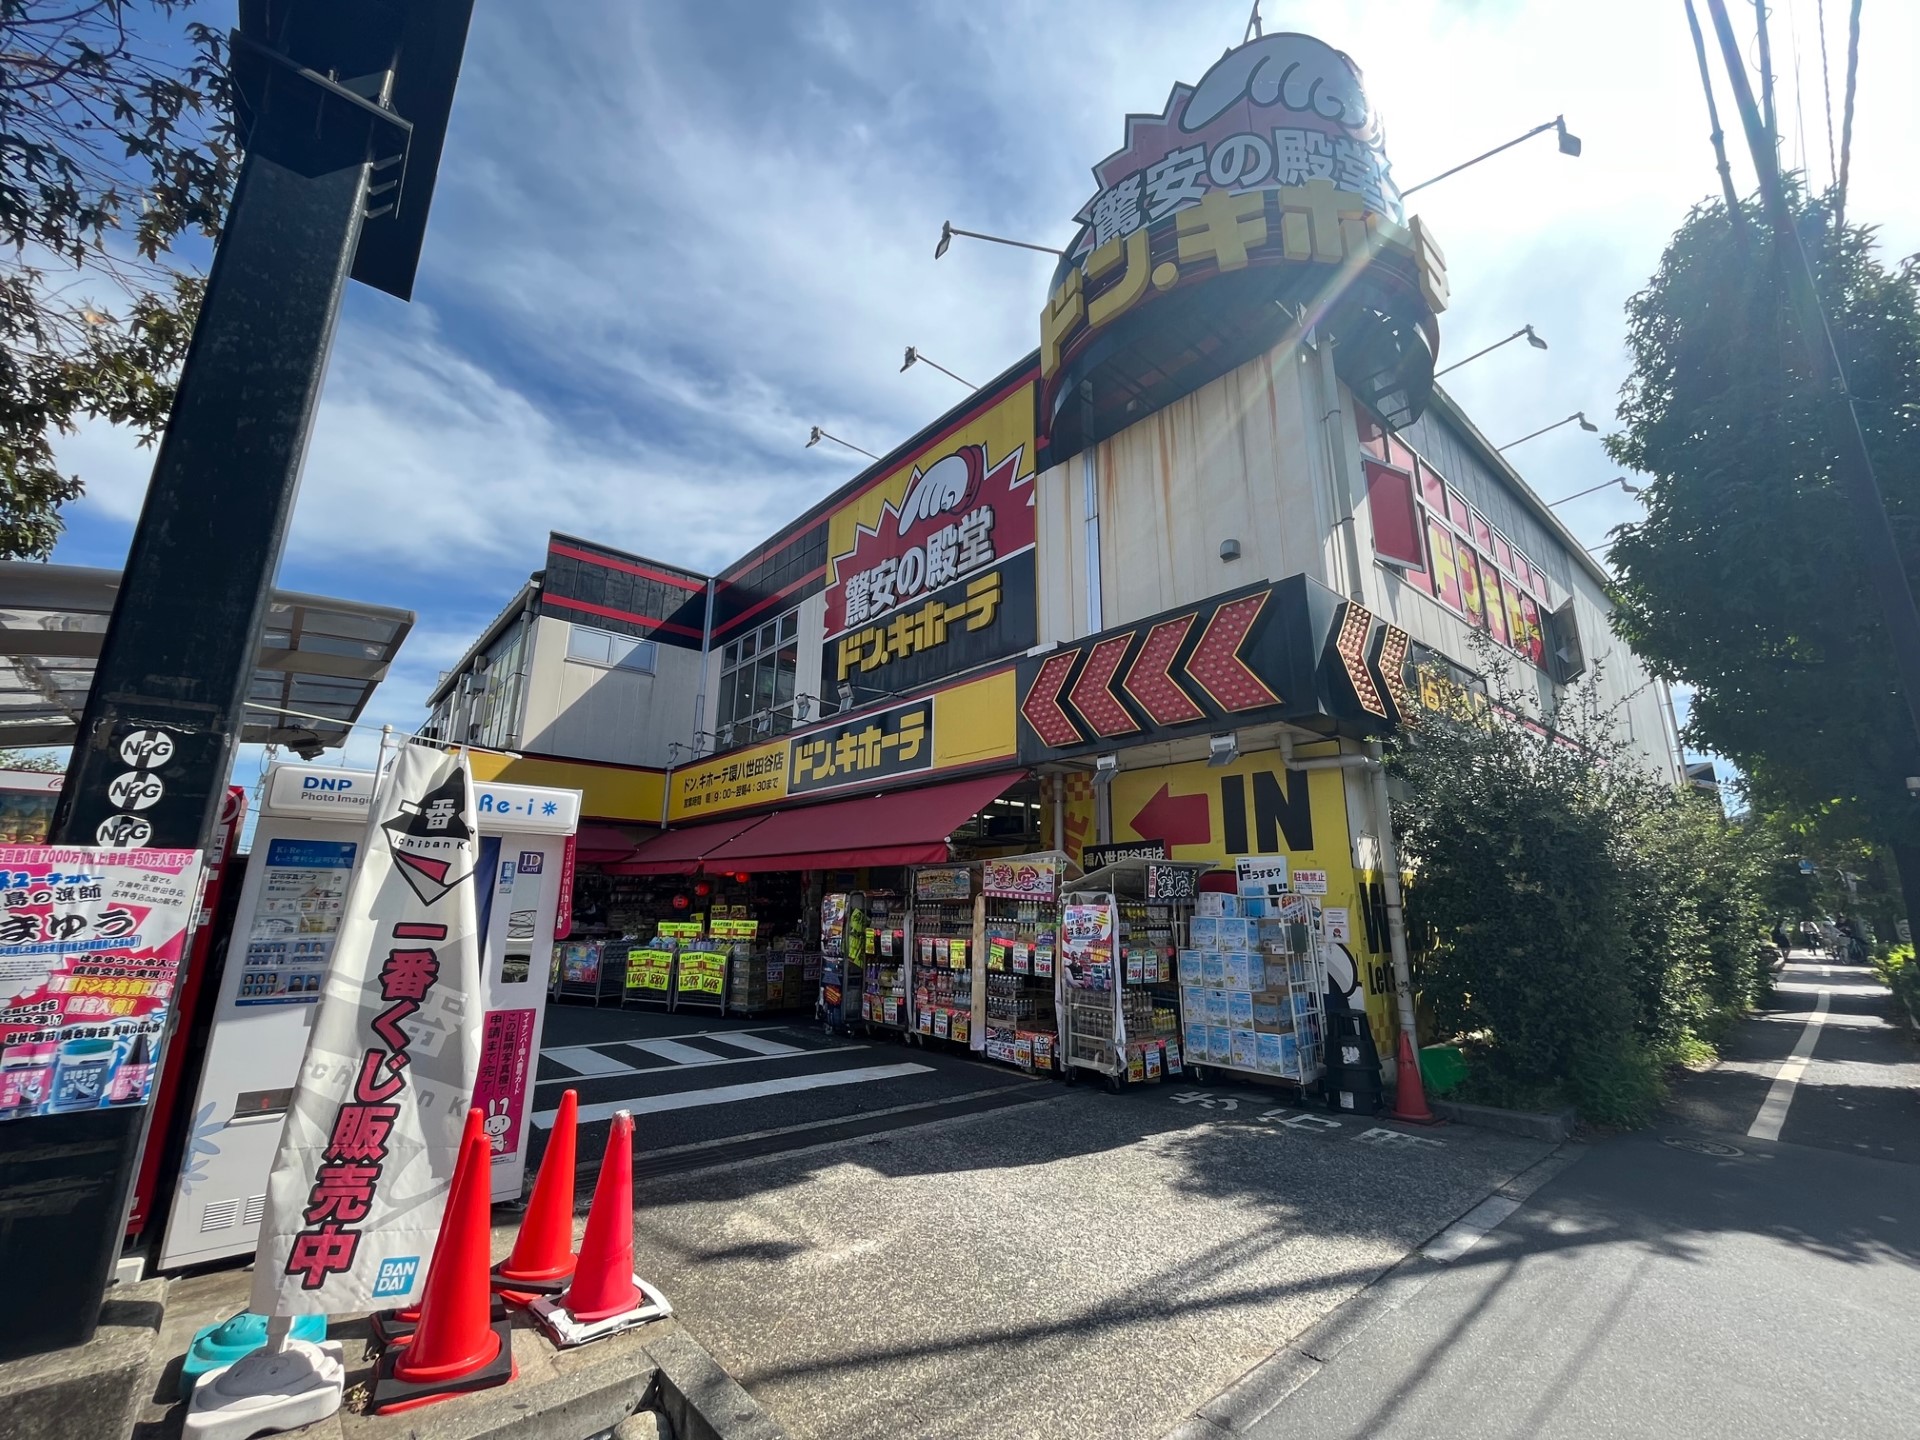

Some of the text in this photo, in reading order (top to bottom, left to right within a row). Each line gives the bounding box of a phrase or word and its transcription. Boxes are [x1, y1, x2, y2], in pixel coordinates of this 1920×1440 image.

[1092, 128, 1390, 242] 驚安の殿堂
[844, 505, 995, 628] 驚安の殿堂
[303, 776, 353, 791] DNP
[301, 792, 335, 802] Photo
[1220, 768, 1314, 855] IN
[522, 853, 541, 866] ID
[1293, 872, 1326, 882] 駐輪禁止
[286, 922, 448, 1290] 一番くじ販売中
[382, 1261, 415, 1275] BAN
[378, 1276, 407, 1292] DAI
